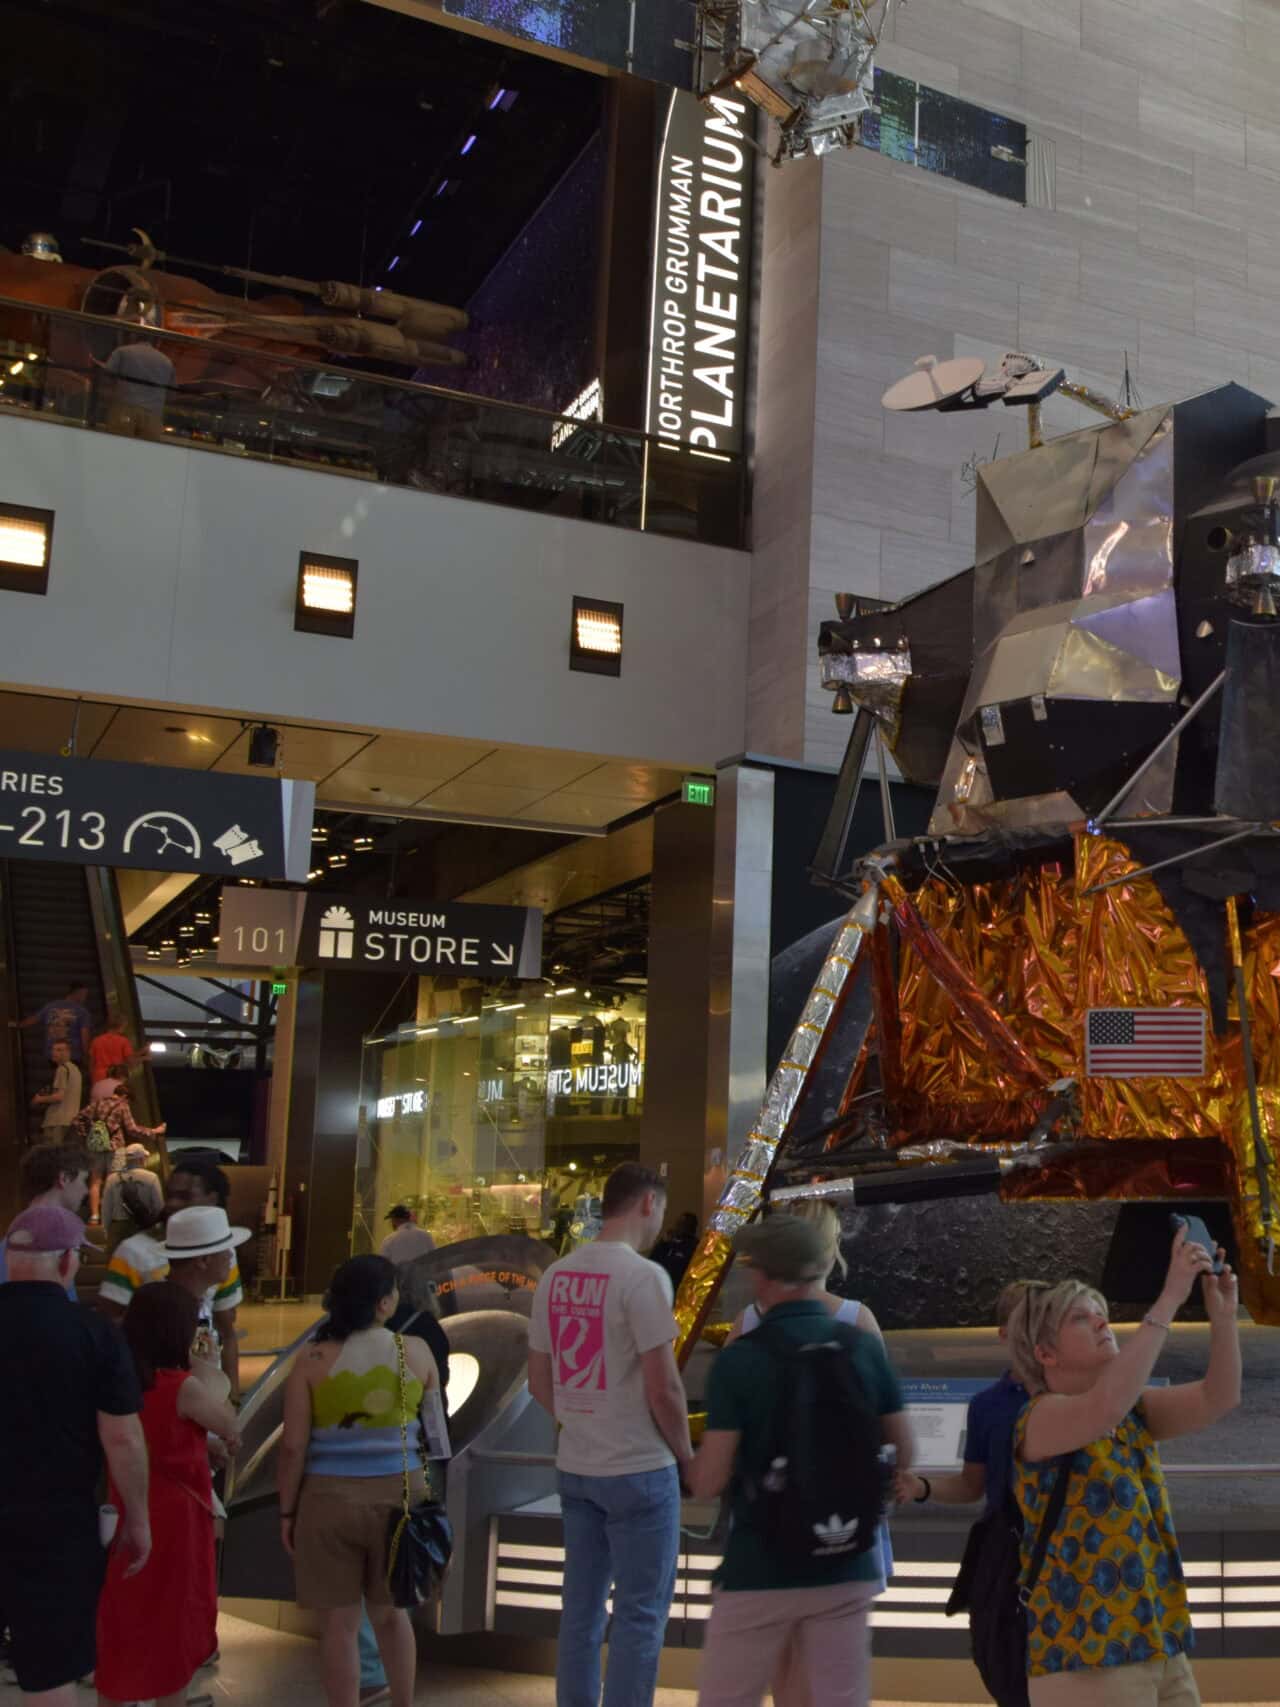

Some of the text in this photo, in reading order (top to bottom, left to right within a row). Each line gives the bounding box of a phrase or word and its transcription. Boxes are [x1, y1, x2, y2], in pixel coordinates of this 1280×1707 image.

[665, 155, 693, 294] GRUMMAN
[689, 95, 746, 462] PLANETARIUM
[0, 771, 64, 796] RIES
[688, 784, 710, 804] EXIT
[369, 910, 446, 929] MUSEUM
[233, 926, 284, 953] 101
[364, 933, 480, 965] STORE
[498, 1272, 510, 1282] OF
[551, 1276, 606, 1305] RUN
